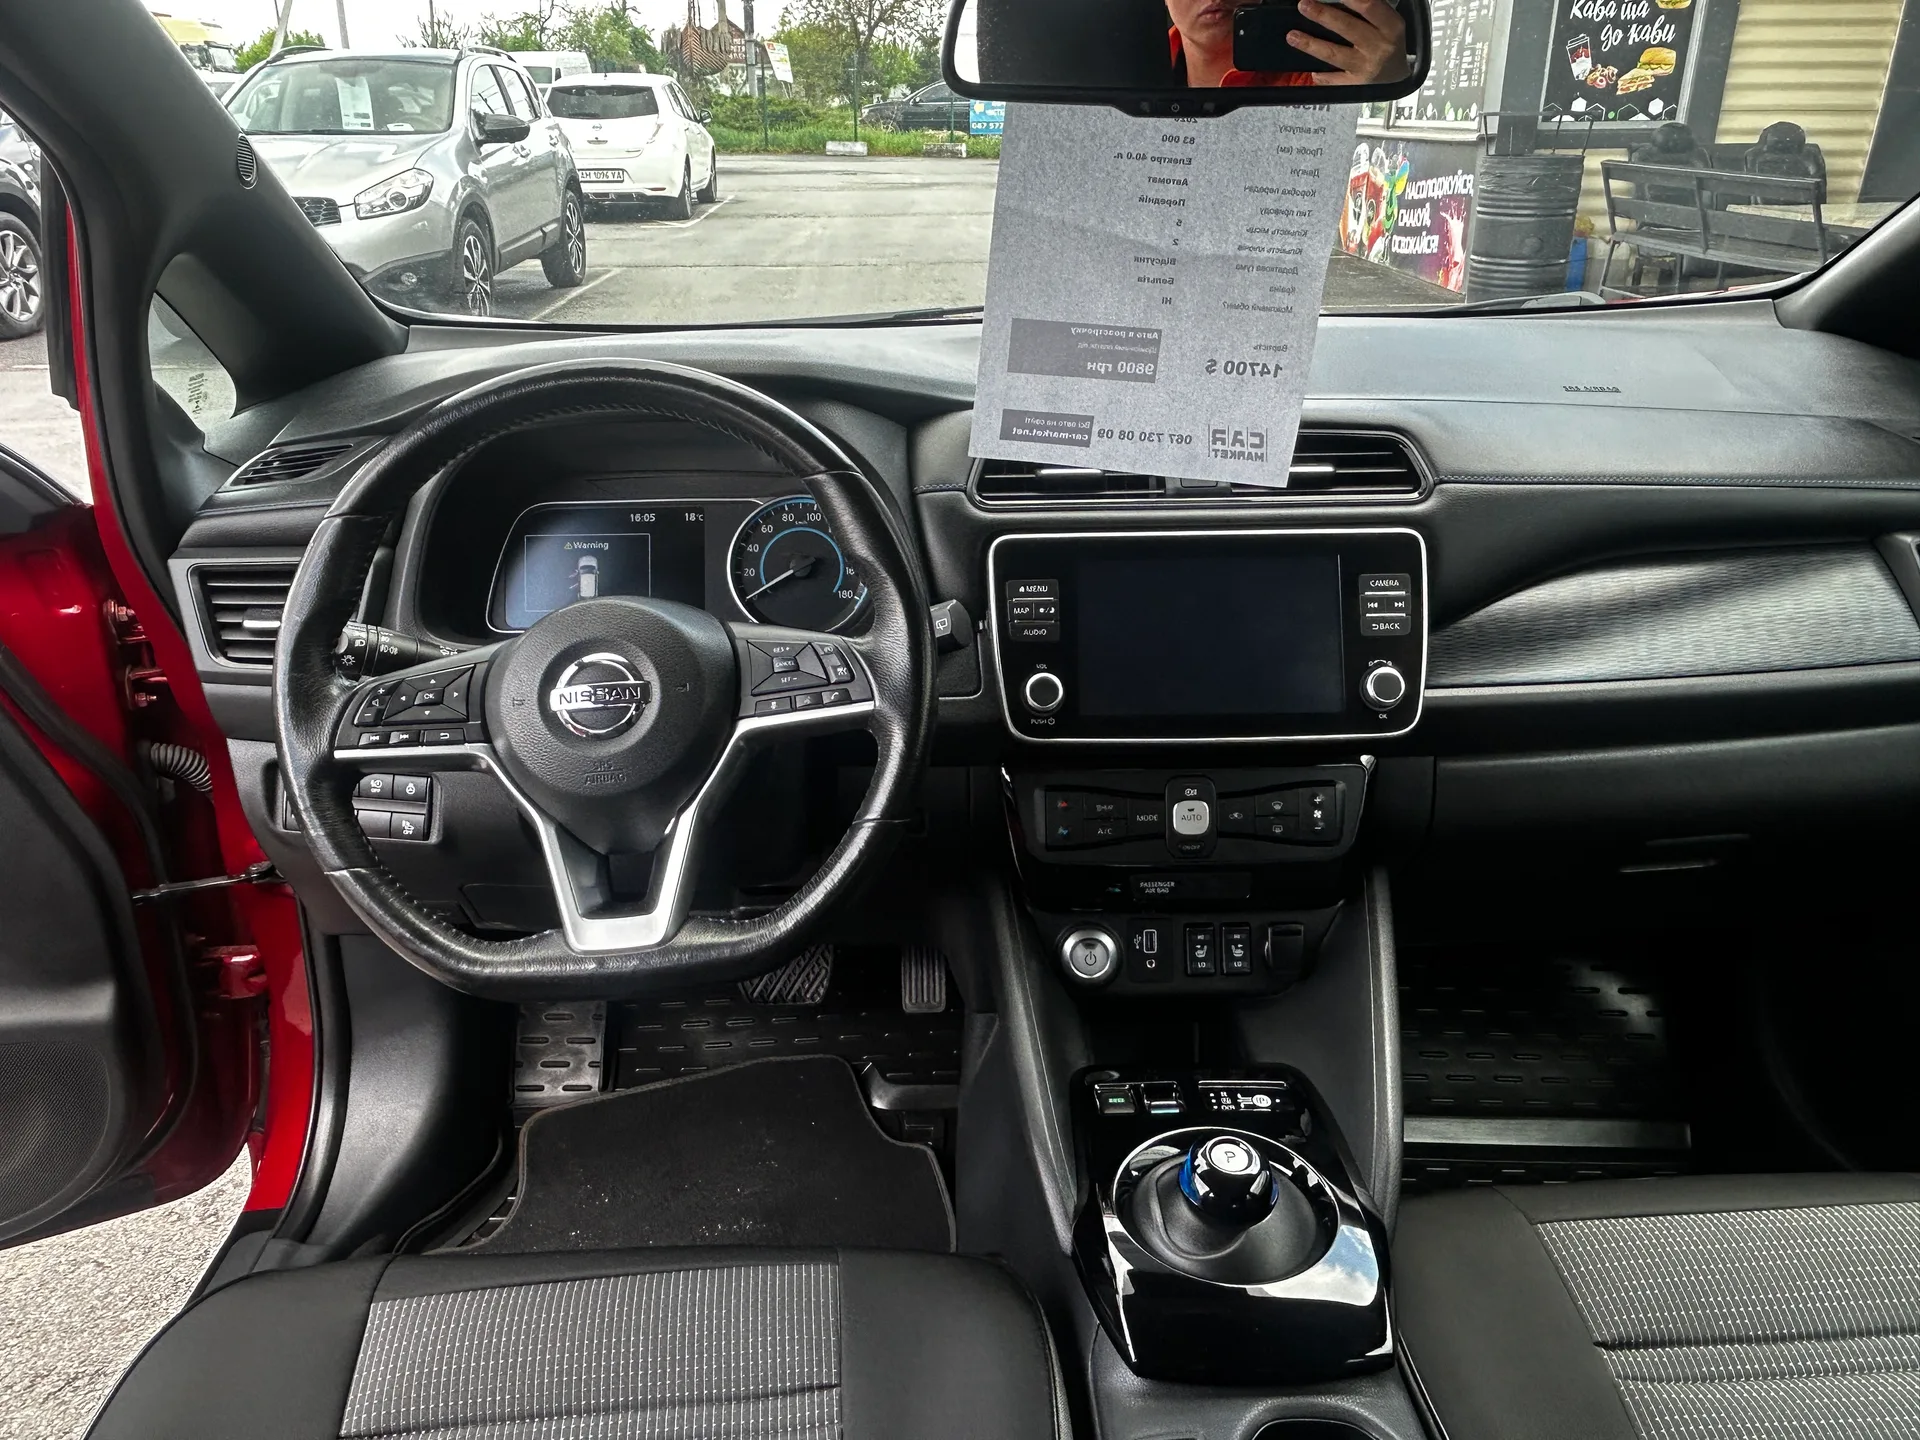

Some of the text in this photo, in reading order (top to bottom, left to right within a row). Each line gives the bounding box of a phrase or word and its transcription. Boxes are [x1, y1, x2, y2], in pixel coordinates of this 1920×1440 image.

[1601, 15, 1676, 51] до кави
[630, 513, 656, 522] 16:05
[782, 513, 795, 522] 80
[806, 512, 822, 521] 100
[761, 524, 773, 533] 60
[573, 541, 609, 551] Warning
[747, 543, 759, 552] 40
[743, 567, 755, 577] 20
[838, 589, 853, 599] 180
[1023, 628, 1047, 636] AUDIO
[559, 686, 641, 705] NISSAN
[1181, 814, 1203, 822] AUTO
[1224, 1151, 1236, 1163] P
